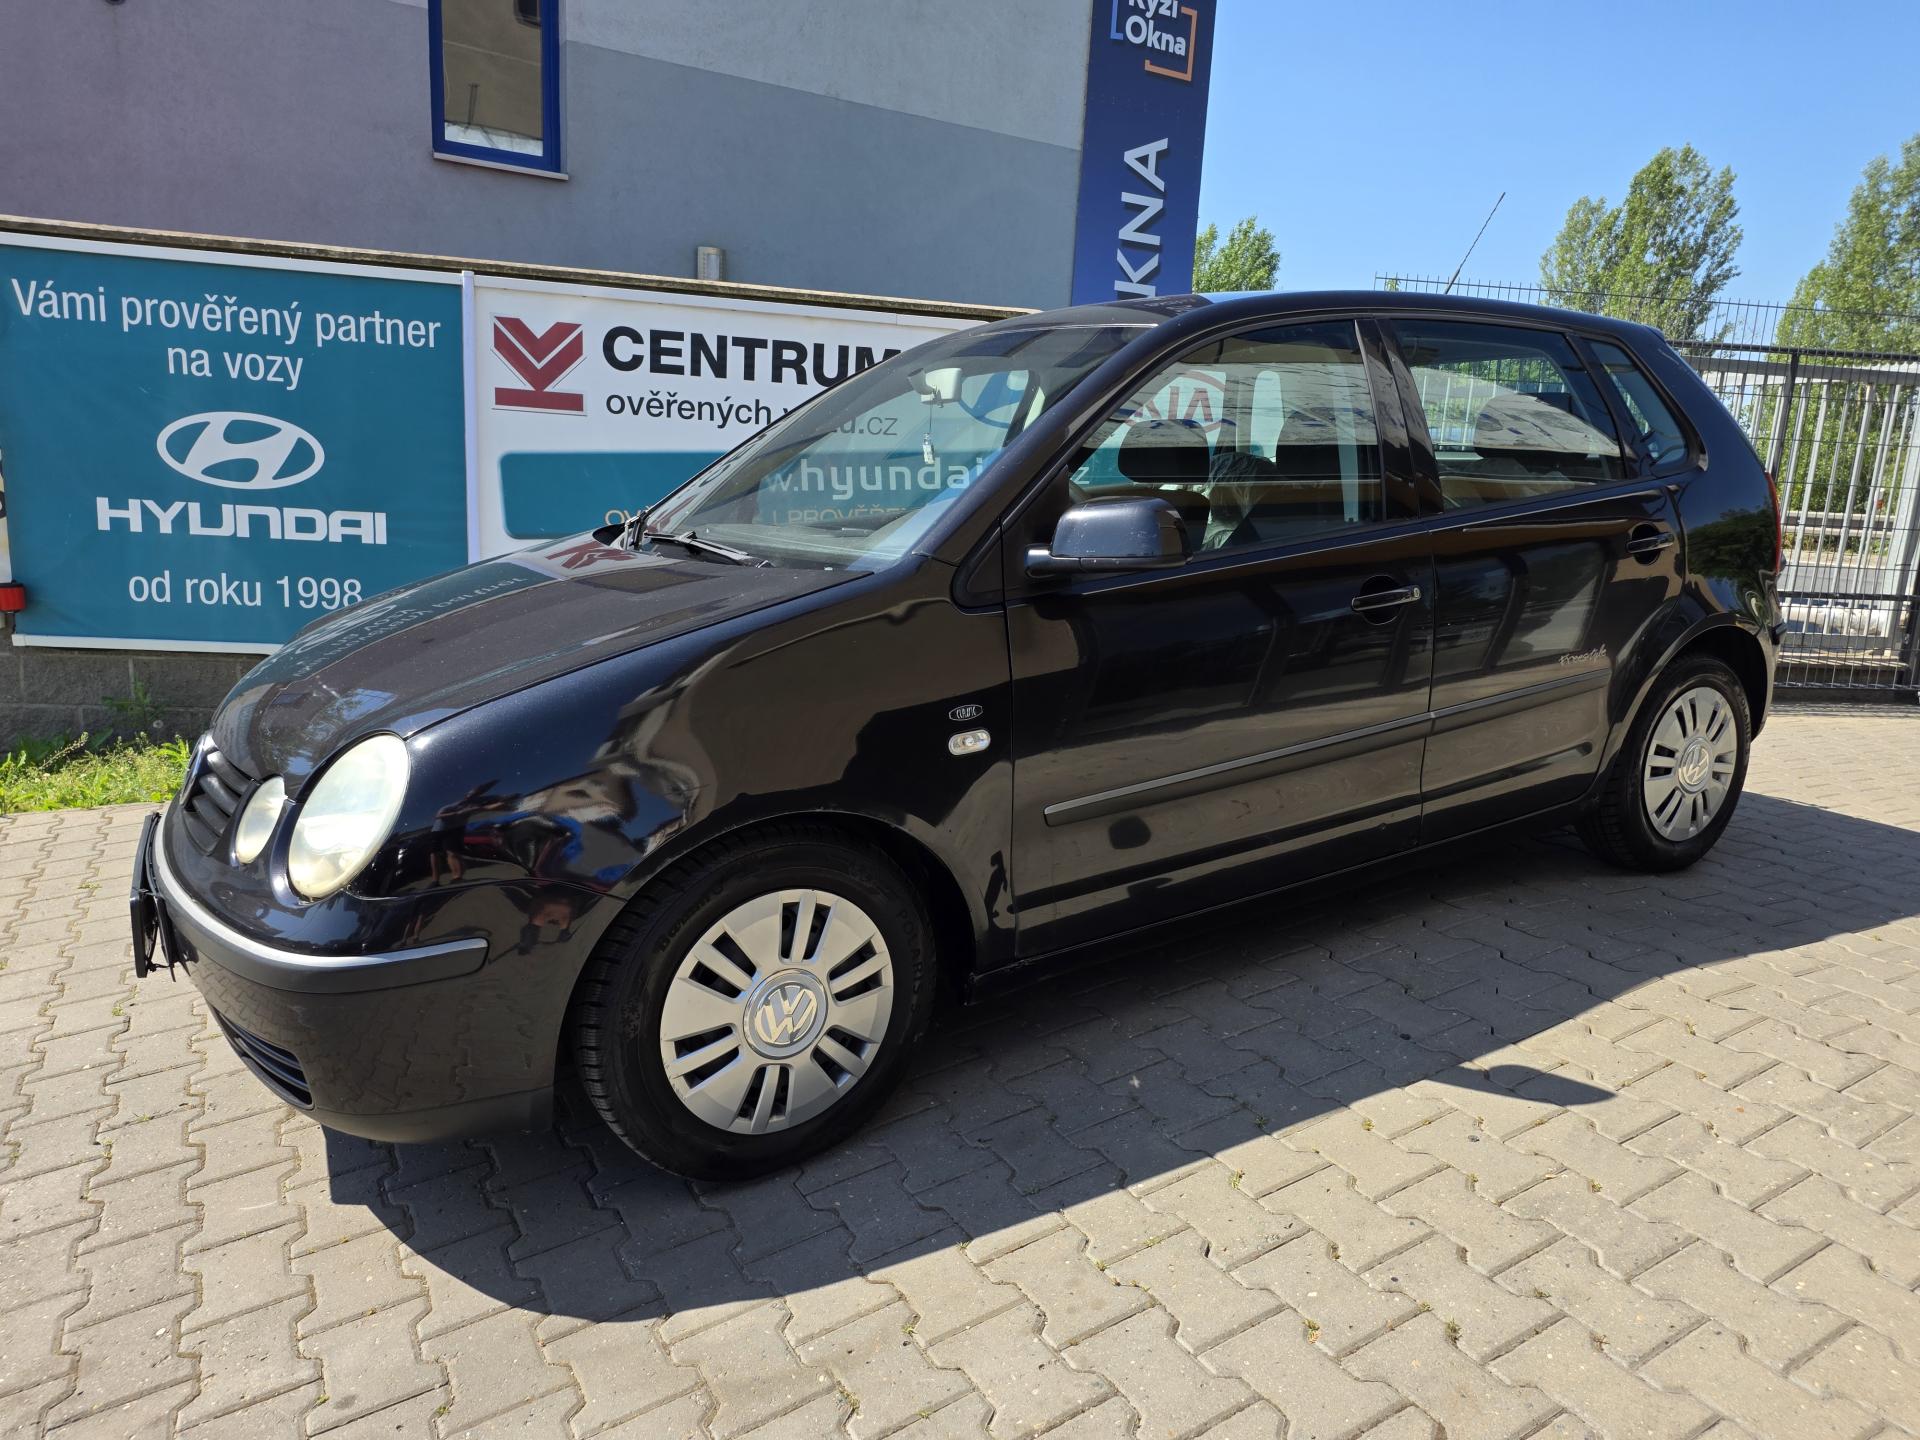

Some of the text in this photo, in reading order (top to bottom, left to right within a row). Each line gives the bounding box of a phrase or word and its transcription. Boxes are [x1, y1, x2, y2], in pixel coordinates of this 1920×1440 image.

[1125, 15, 1186, 56] Okna
[11, 278, 441, 348] Vámi prověřený partner
[167, 346, 303, 391] na vozy
[605, 390, 772, 429] ověřených
[96, 496, 387, 545] HYUNDAI
[128, 570, 363, 610] od roku 1998
